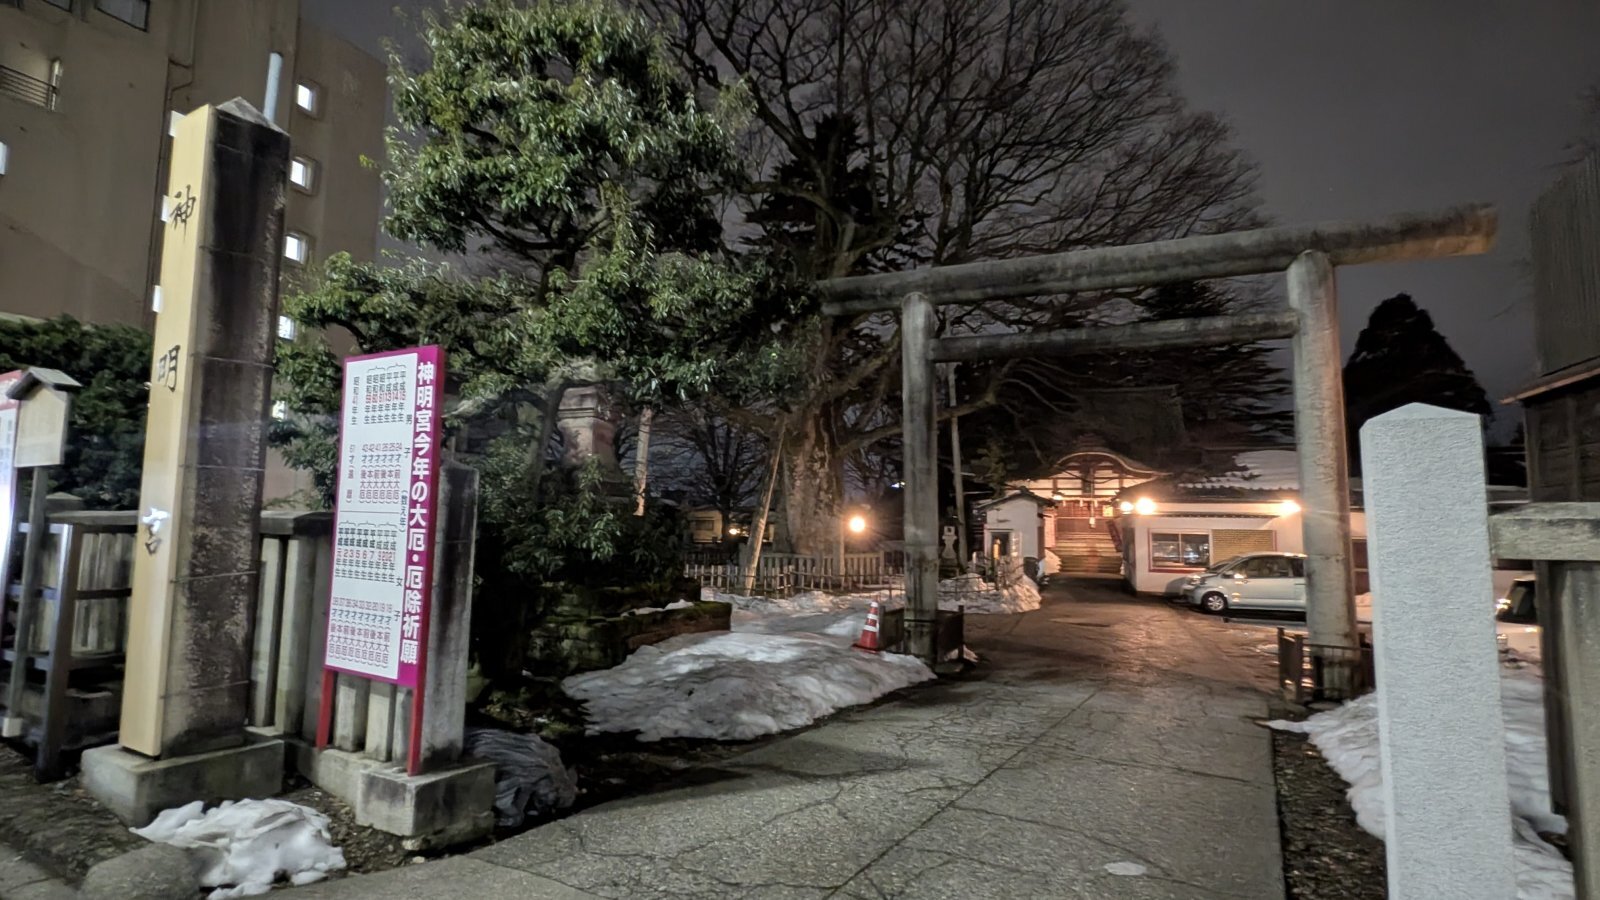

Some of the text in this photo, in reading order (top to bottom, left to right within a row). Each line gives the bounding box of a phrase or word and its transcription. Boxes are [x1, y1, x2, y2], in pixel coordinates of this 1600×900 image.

[401, 361, 434, 664] 神明宮今年の大厄・厄除祈願
